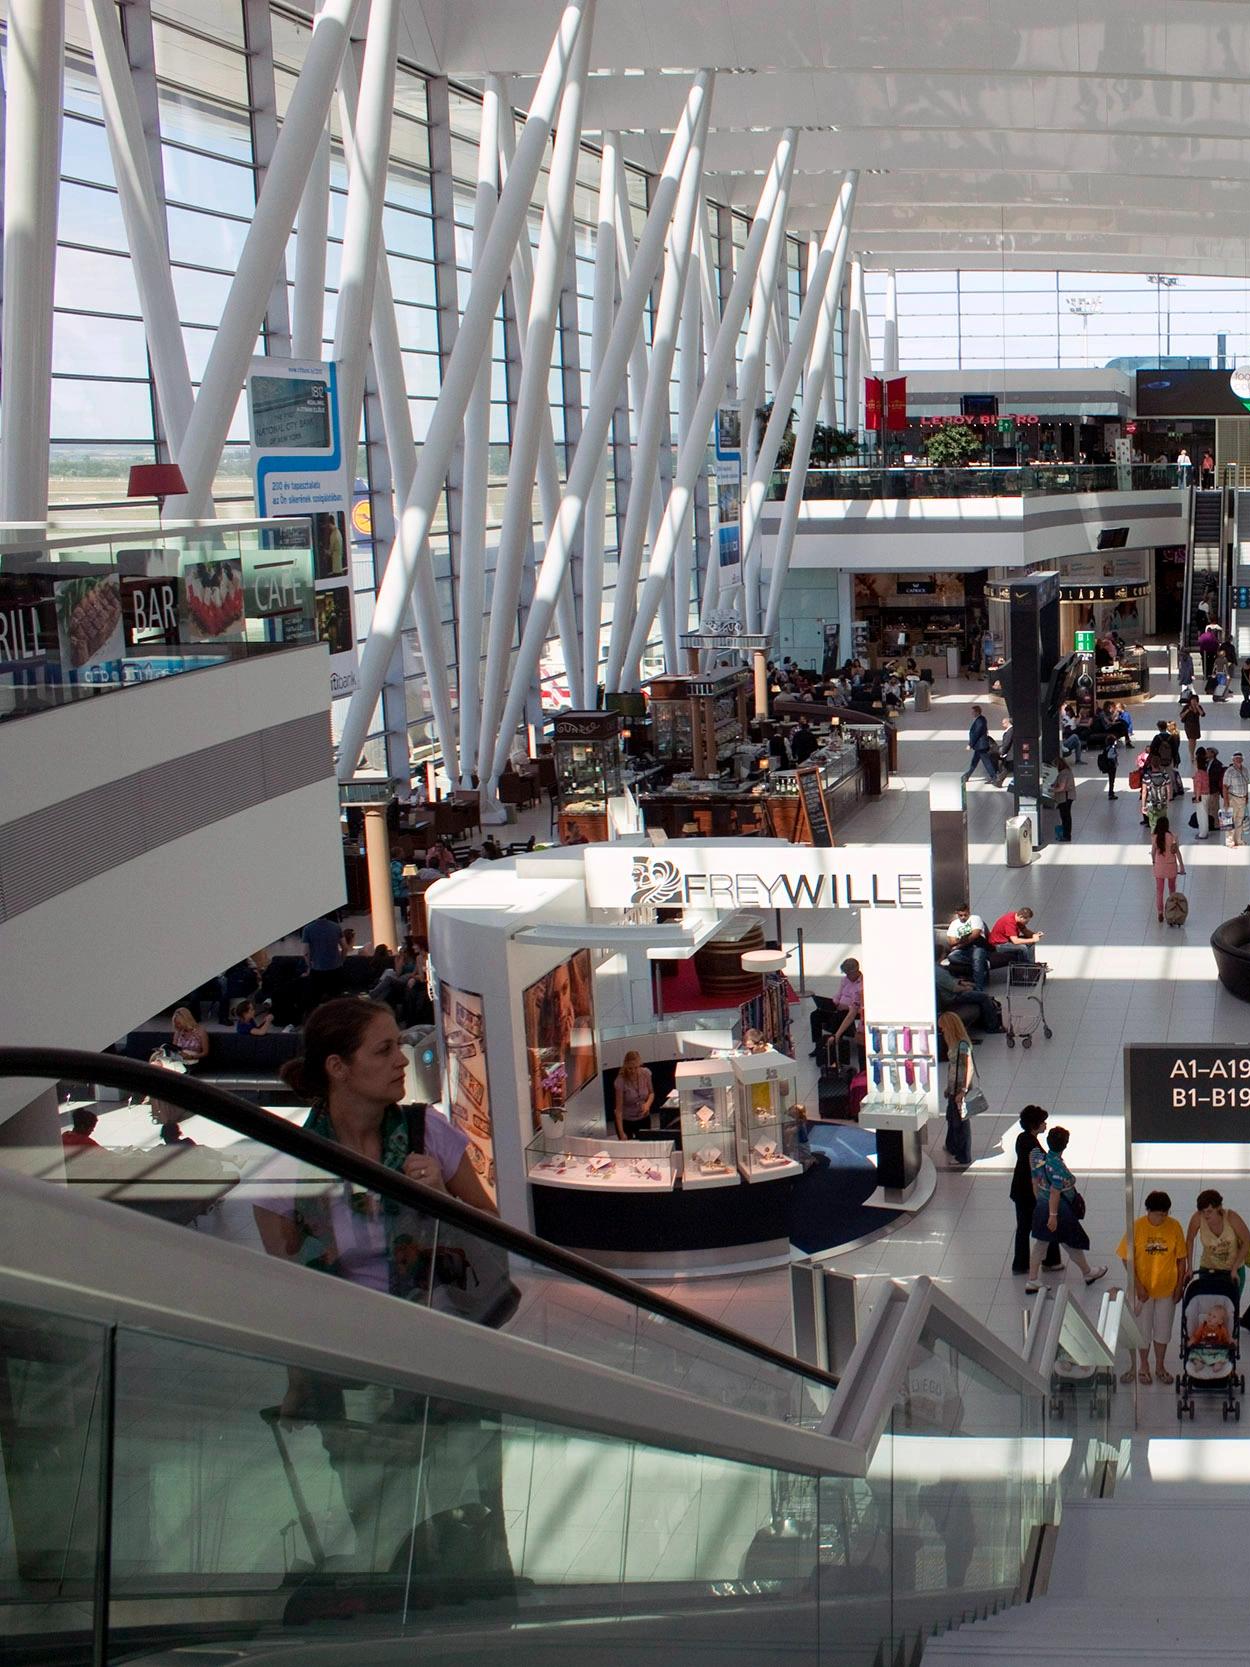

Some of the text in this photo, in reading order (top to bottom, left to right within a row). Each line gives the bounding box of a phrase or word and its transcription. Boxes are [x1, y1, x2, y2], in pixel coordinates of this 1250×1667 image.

[920, 414, 1039, 425] LEROY BIRO
[133, 585, 177, 634] BAR
[254, 558, 303, 612] CAFÉ
[0, 606, 46, 662] RILL
[330, 671, 357, 691] itibank
